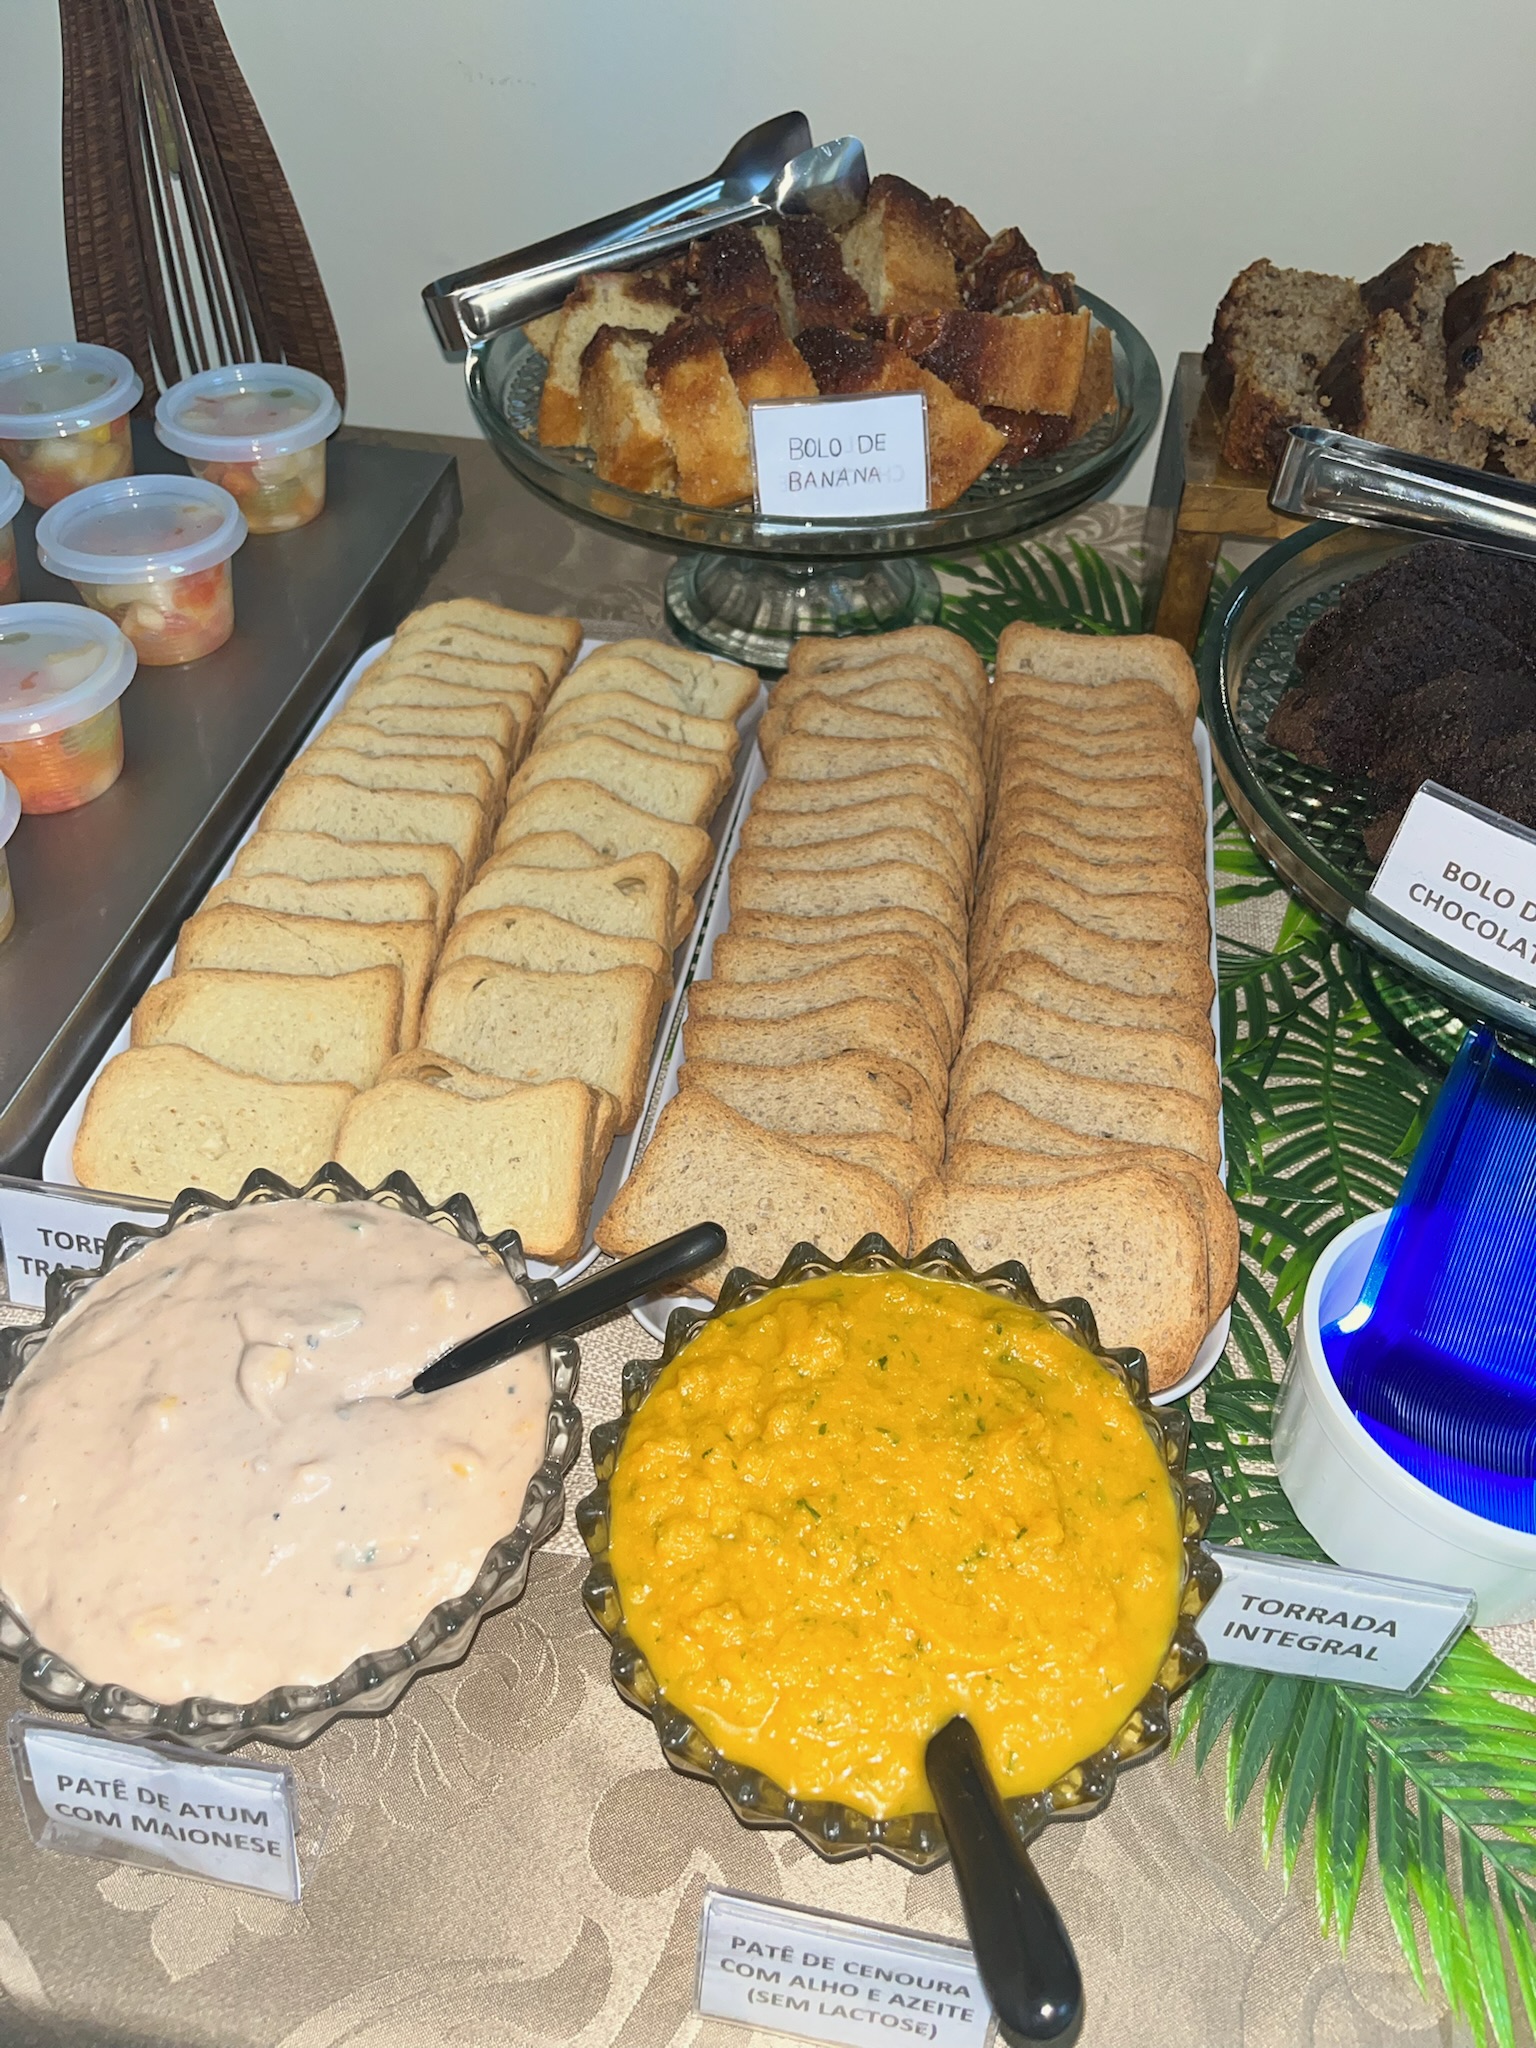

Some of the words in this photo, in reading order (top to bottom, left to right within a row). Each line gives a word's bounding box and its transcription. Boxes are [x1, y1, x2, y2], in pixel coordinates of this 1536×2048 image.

[789, 437, 842, 461] BOLO
[858, 433, 887, 454] DE
[789, 466, 881, 492] BANANA
[1442, 861, 1515, 909] BOLO
[1519, 900, 1536, 922] D
[37, 1227, 107, 1256] TORR
[1222, 1621, 1379, 1661] INTEGRAL
[1241, 1594, 1397, 1638] TORRADA
[57, 1774, 129, 1801] PATÊ
[137, 1786, 172, 1812] DE
[179, 1802, 269, 1827] ATUM
[55, 1803, 122, 1828] COM
[132, 1815, 282, 1858] MAIONESE
[720, 1958, 781, 1984] COM
[789, 1975, 859, 1998] ALHO
[868, 1988, 882, 2002] E
[888, 1993, 976, 2023] AZEITE
[731, 1935, 793, 1963] PATÊ
[802, 1952, 836, 1971] DE
[843, 1962, 971, 1998] CENOURA
[747, 1987, 810, 2013] (SEM
[818, 2003, 938, 2040] LACTOSE)
